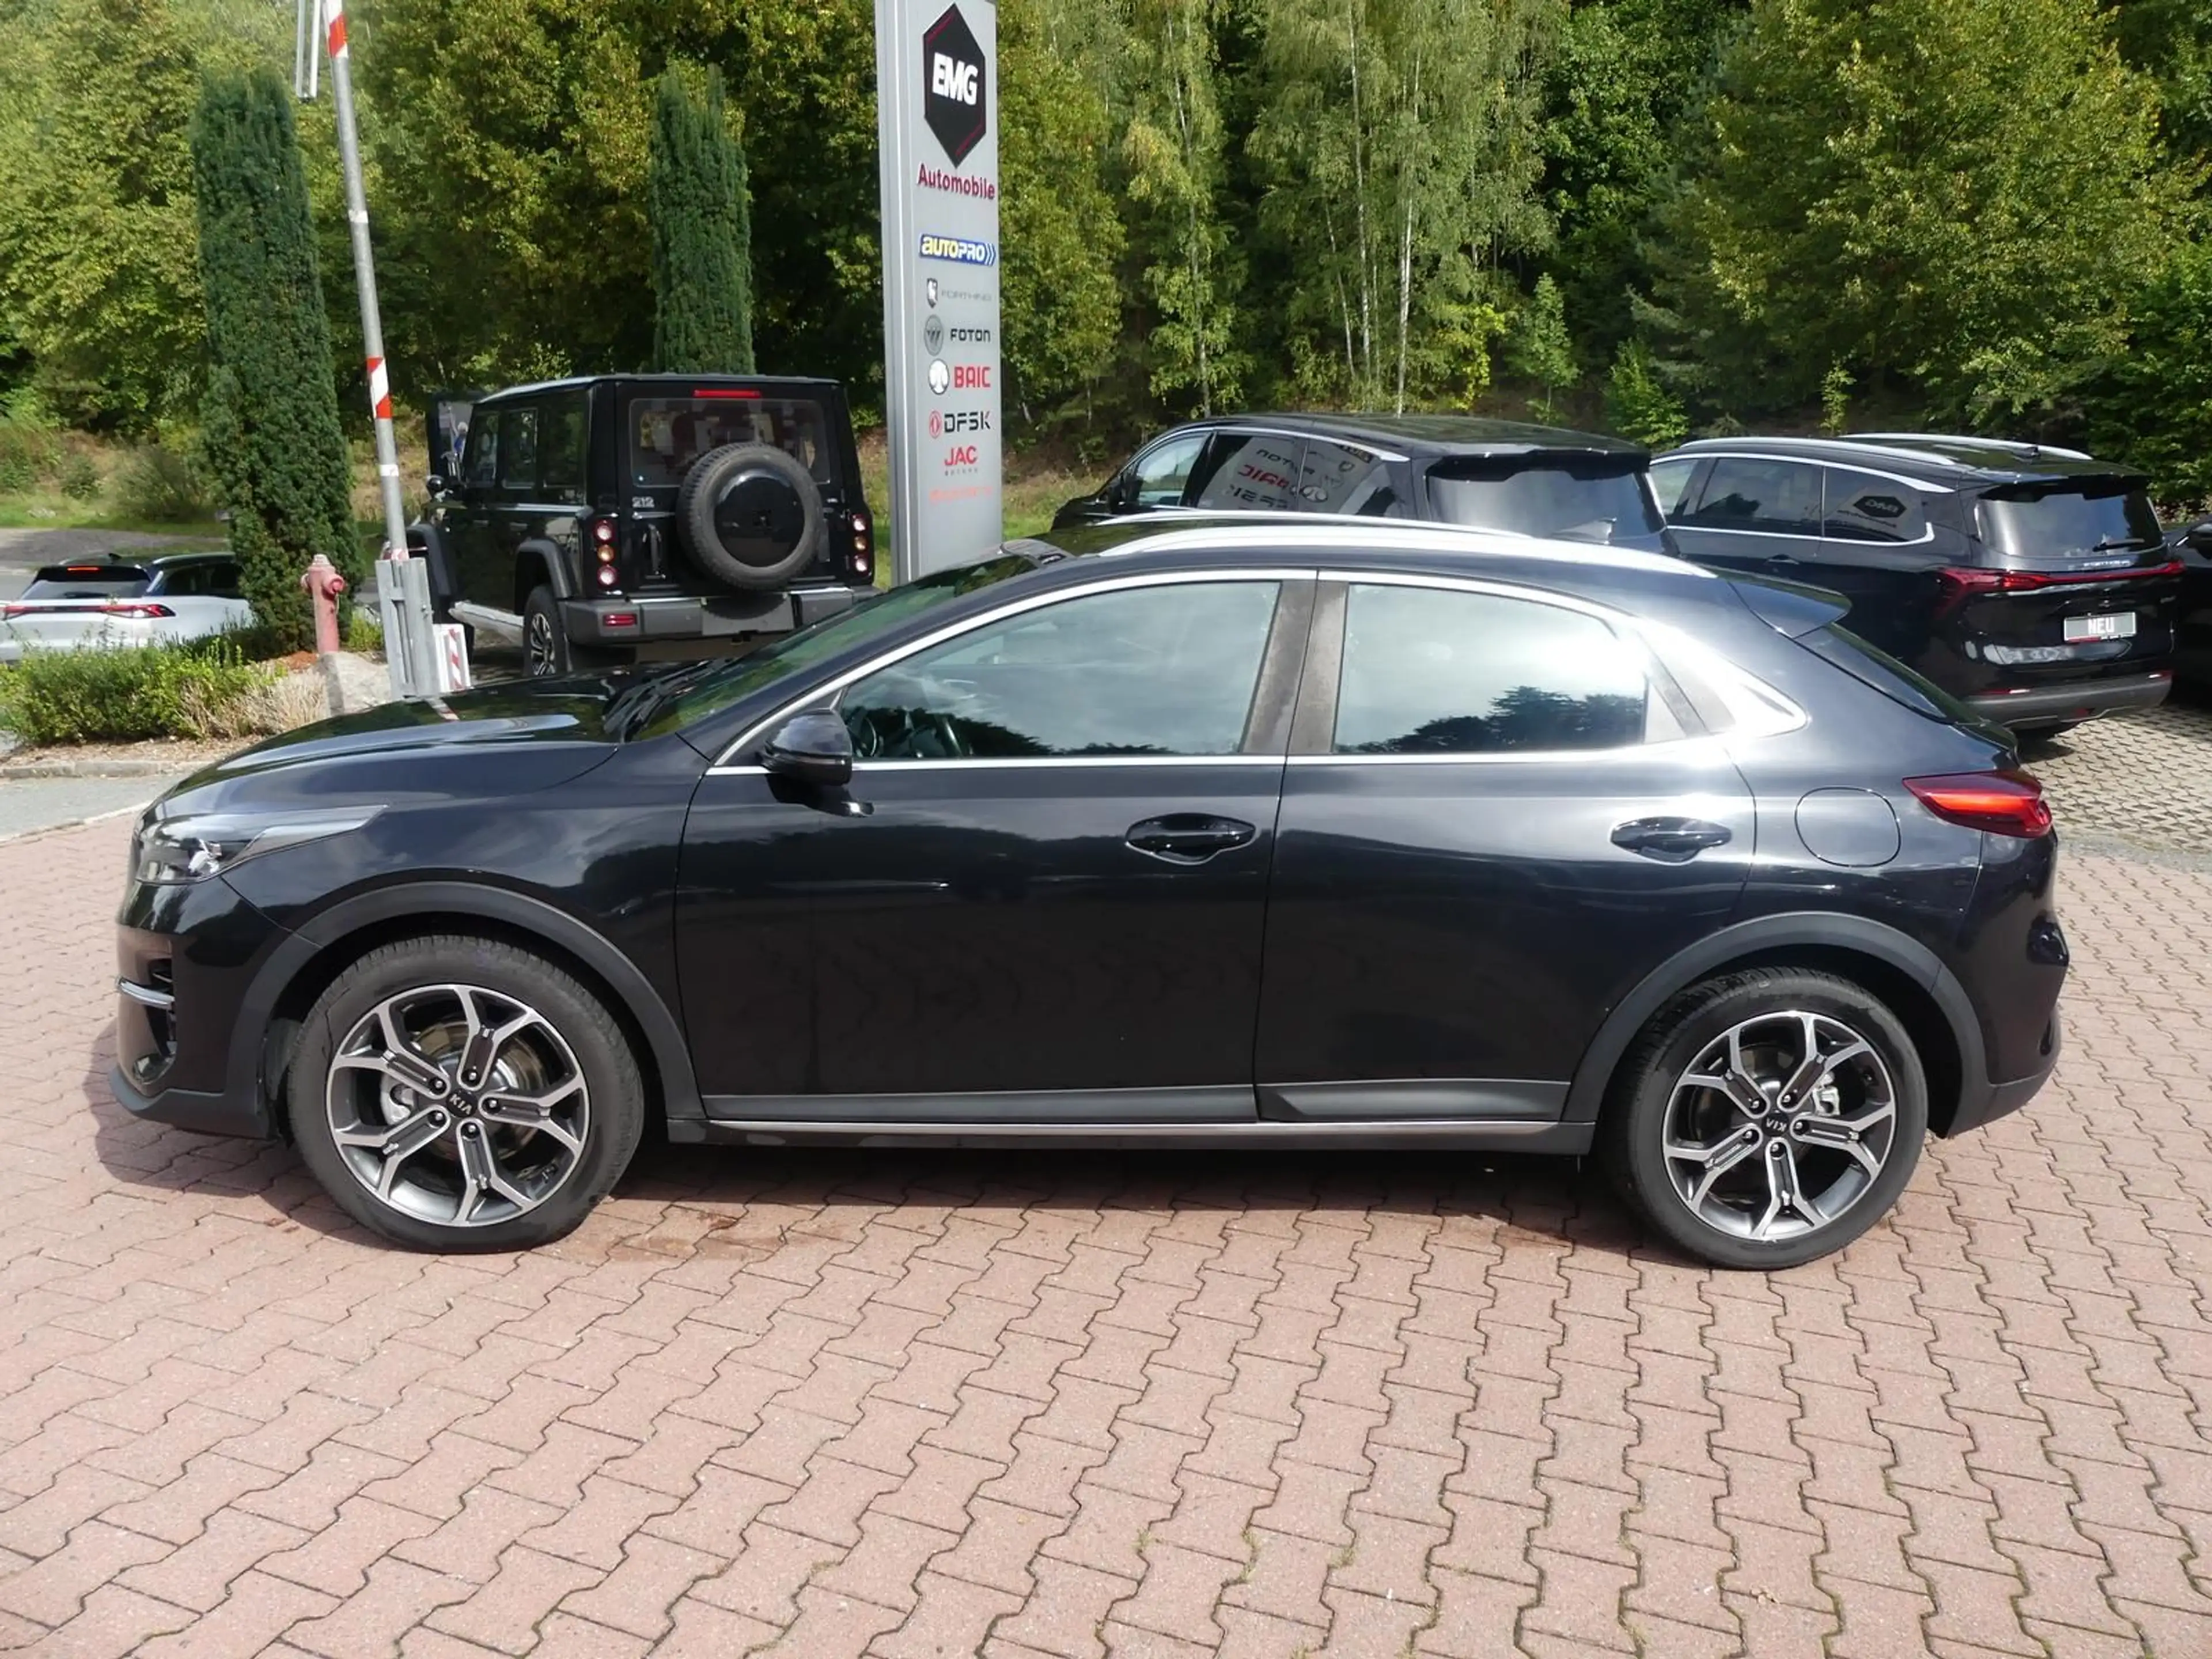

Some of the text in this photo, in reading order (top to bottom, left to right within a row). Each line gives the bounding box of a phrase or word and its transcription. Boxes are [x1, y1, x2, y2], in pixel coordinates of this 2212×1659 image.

[932, 52, 978, 105] EMG
[918, 163, 995, 200] Automobile
[950, 328, 991, 342] FOTON
[954, 366, 991, 388] BAIC
[944, 411, 990, 432] DFSK
[944, 446, 978, 465] JAC
[632, 496, 654, 507] 212
[2088, 616, 2115, 635] NEU
[449, 1093, 472, 1115] KIA
[1766, 1118, 1787, 1132] KIA
